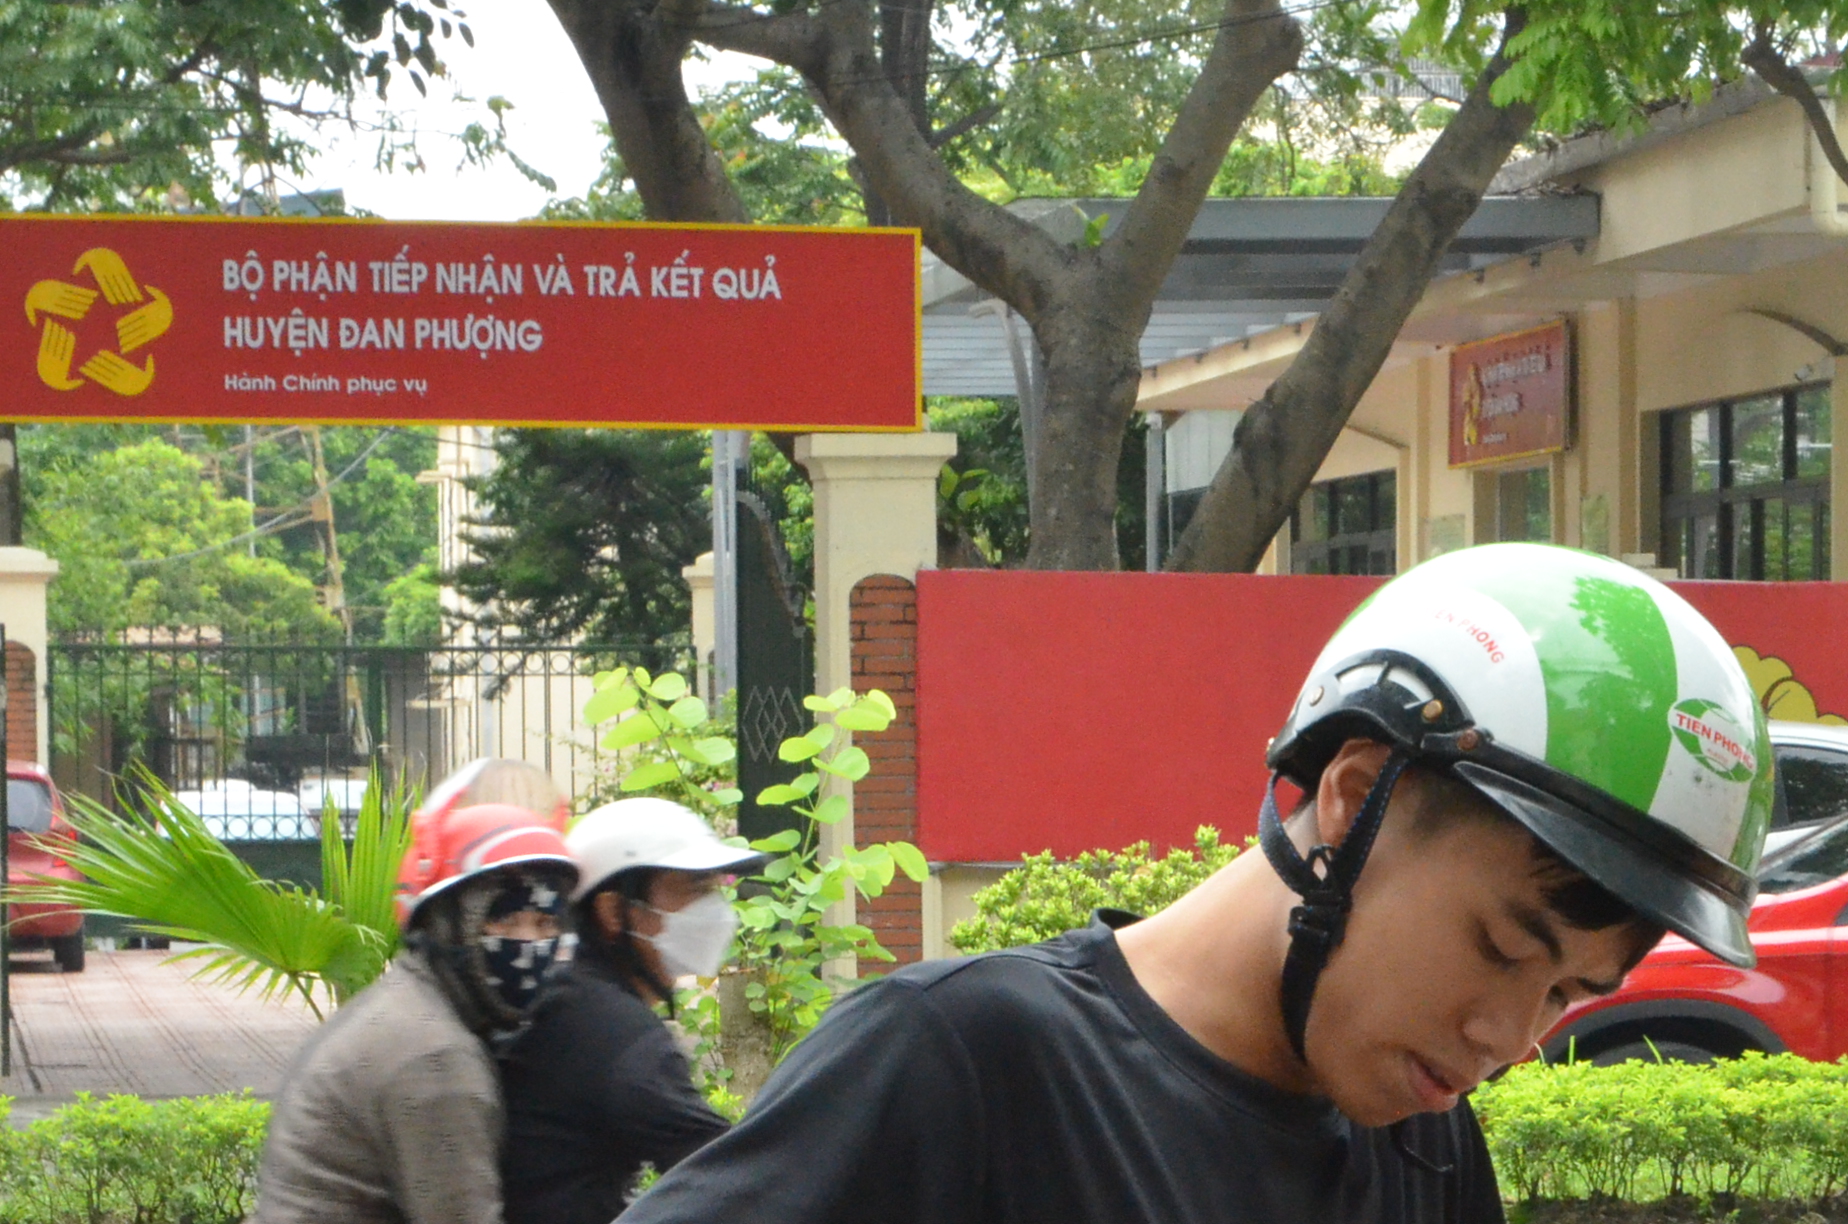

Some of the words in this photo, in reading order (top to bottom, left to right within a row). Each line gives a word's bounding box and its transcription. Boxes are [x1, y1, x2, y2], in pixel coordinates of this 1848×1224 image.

[222, 248, 265, 301] BỘ
[272, 250, 358, 301] PHẬN
[368, 244, 429, 293] TIẾP
[435, 253, 523, 304] NHẬN
[532, 252, 575, 296] VÀ
[583, 251, 642, 298] TRẢ
[650, 249, 705, 298] KẾT
[711, 254, 783, 300] QUẢ
[223, 307, 330, 358] HUYỆN
[338, 317, 406, 350] ĐAN
[413, 313, 544, 360] PHƯỢNG
[224, 371, 277, 392] Hành
[282, 372, 341, 392] Chính
[346, 374, 398, 398] phục
[403, 378, 428, 397] vụ
[1457, 618, 1505, 664] PHONG
[1675, 712, 1713, 740] TIEN
[1713, 730, 1754, 770] PHONG
